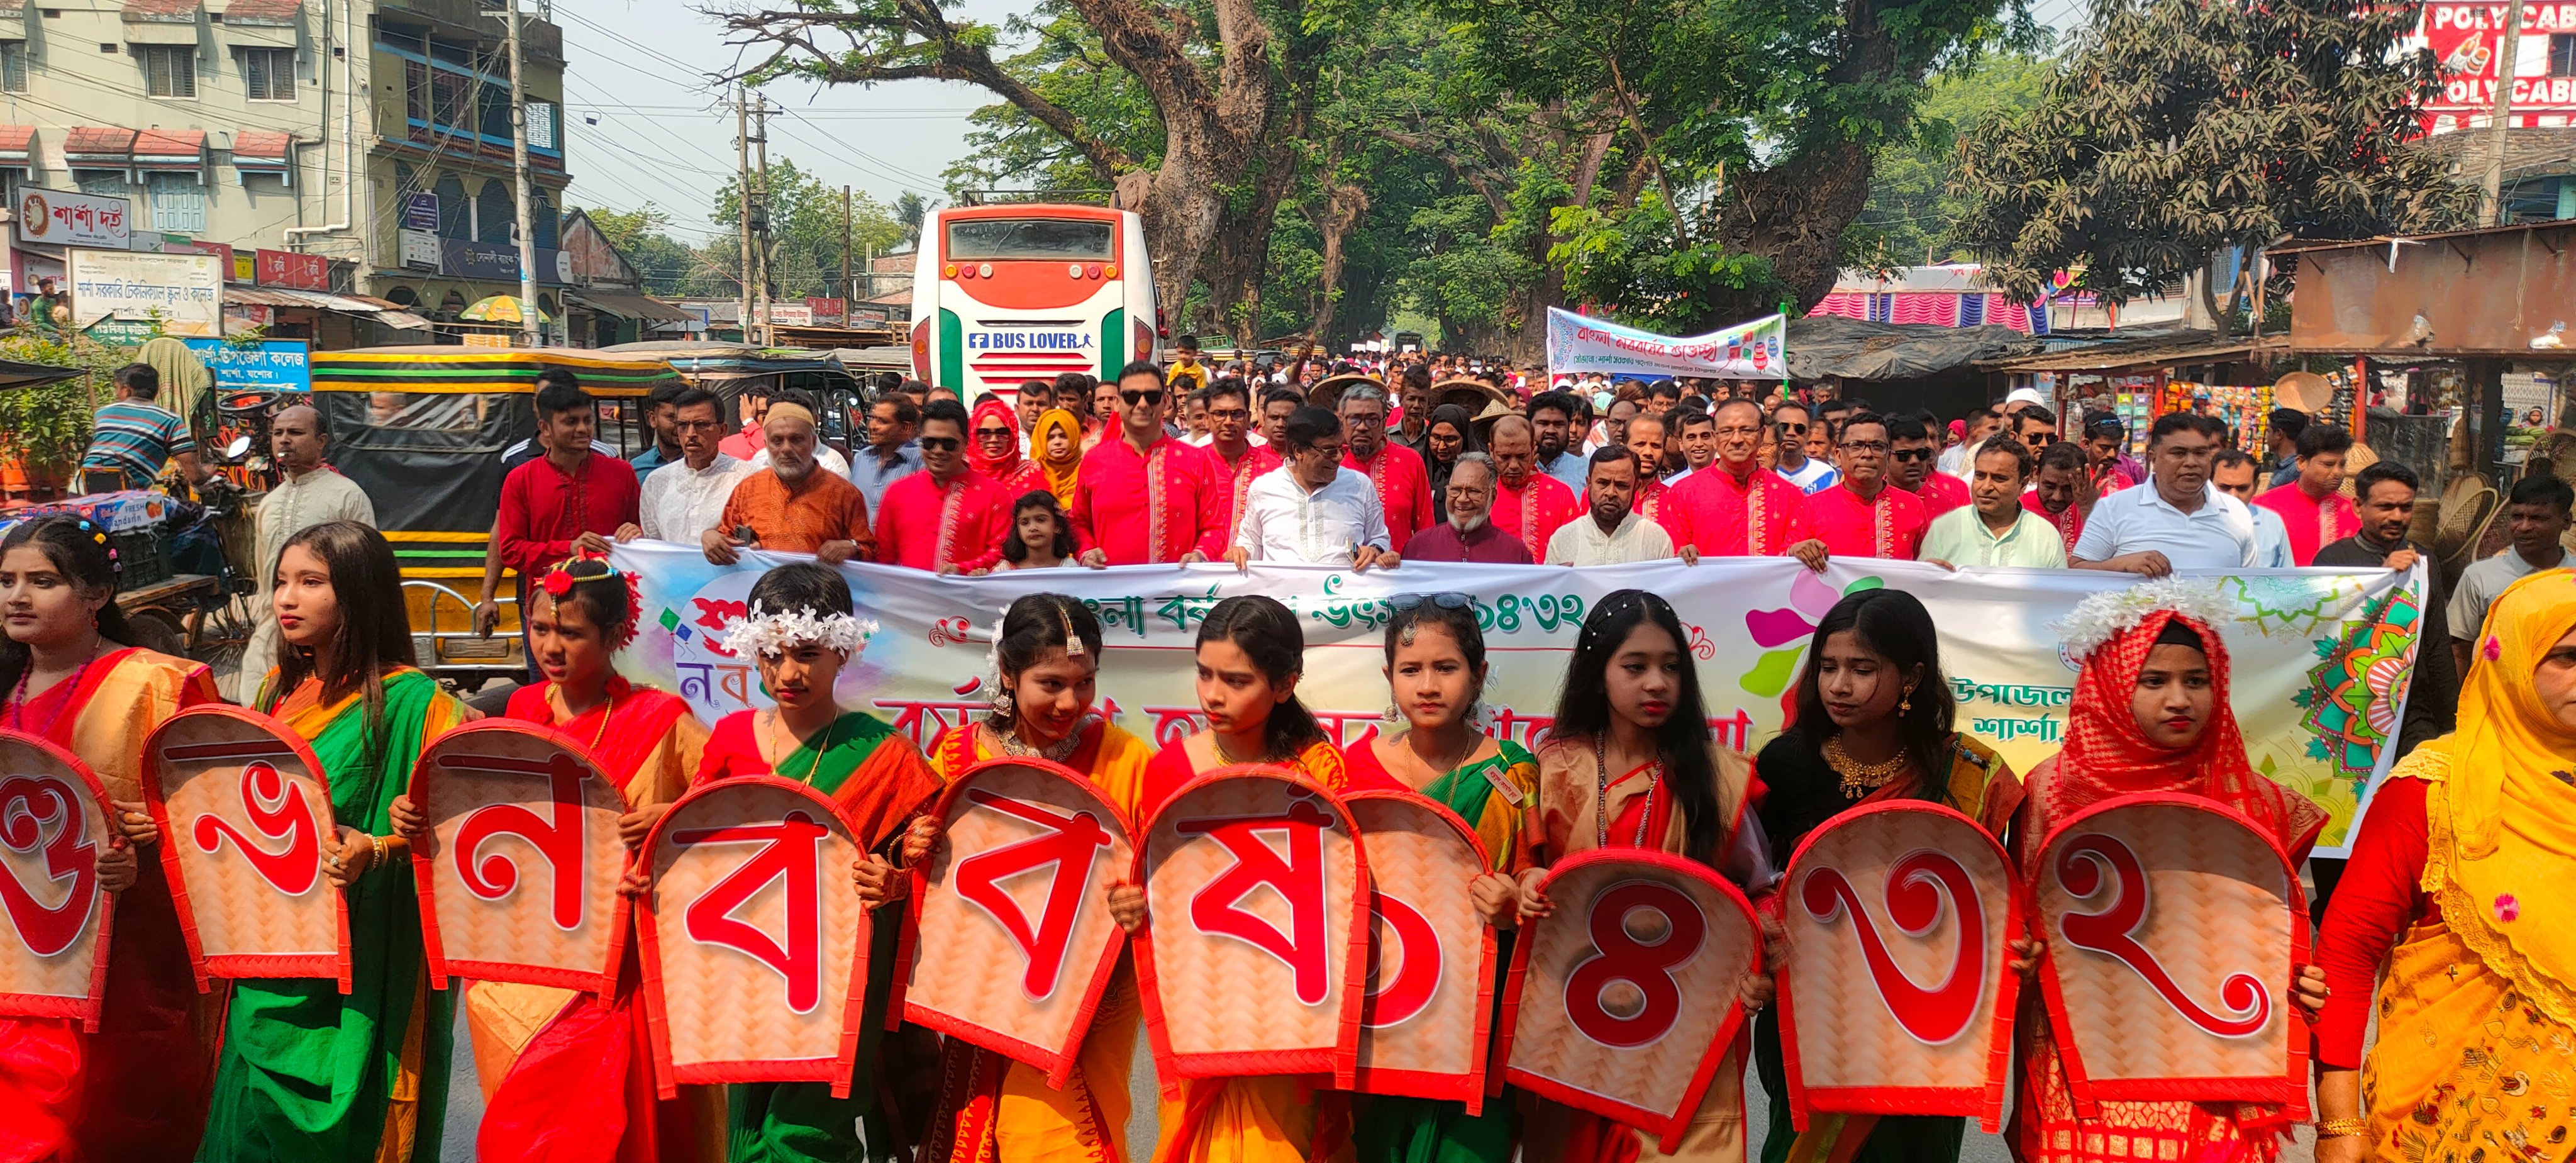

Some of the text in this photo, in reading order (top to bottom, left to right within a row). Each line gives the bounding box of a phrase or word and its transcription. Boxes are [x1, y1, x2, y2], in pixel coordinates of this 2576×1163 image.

[2436, 5, 2509, 30] POLY
[2429, 79, 2497, 103] OLY
[53, 201, 126, 238] শার্শা দই
[77, 279, 94, 298] শার্শা
[95, 278, 123, 299] সরকারি
[125, 279, 165, 300] টেকনিক্যাল
[167, 286, 181, 305] স্কুল
[183, 290, 189, 301] ও
[191, 287, 214, 303] কলেজ
[219, 348, 267, 367] উপজেলা
[269, 352, 305, 367] কলেজ
[993, 333, 1025, 348] BUS
[1030, 333, 1077, 348] LOVER
[1577, 326, 1717, 362] বাংলা নববর্ষের শুভেচ্ছা
[247, 369, 273, 379] যশোর
[125, 504, 145, 513] FRESH
[1948, 677, 2074, 707] উপজেল
[162, 739, 322, 896] ভ
[438, 751, 594, 931] ন
[955, 786, 1114, 1001] ব
[670, 810, 830, 1015] ব
[1801, 847, 1988, 1046] ৩
[2054, 832, 2272, 1039] ২
[1563, 879, 1709, 1050] ৪
